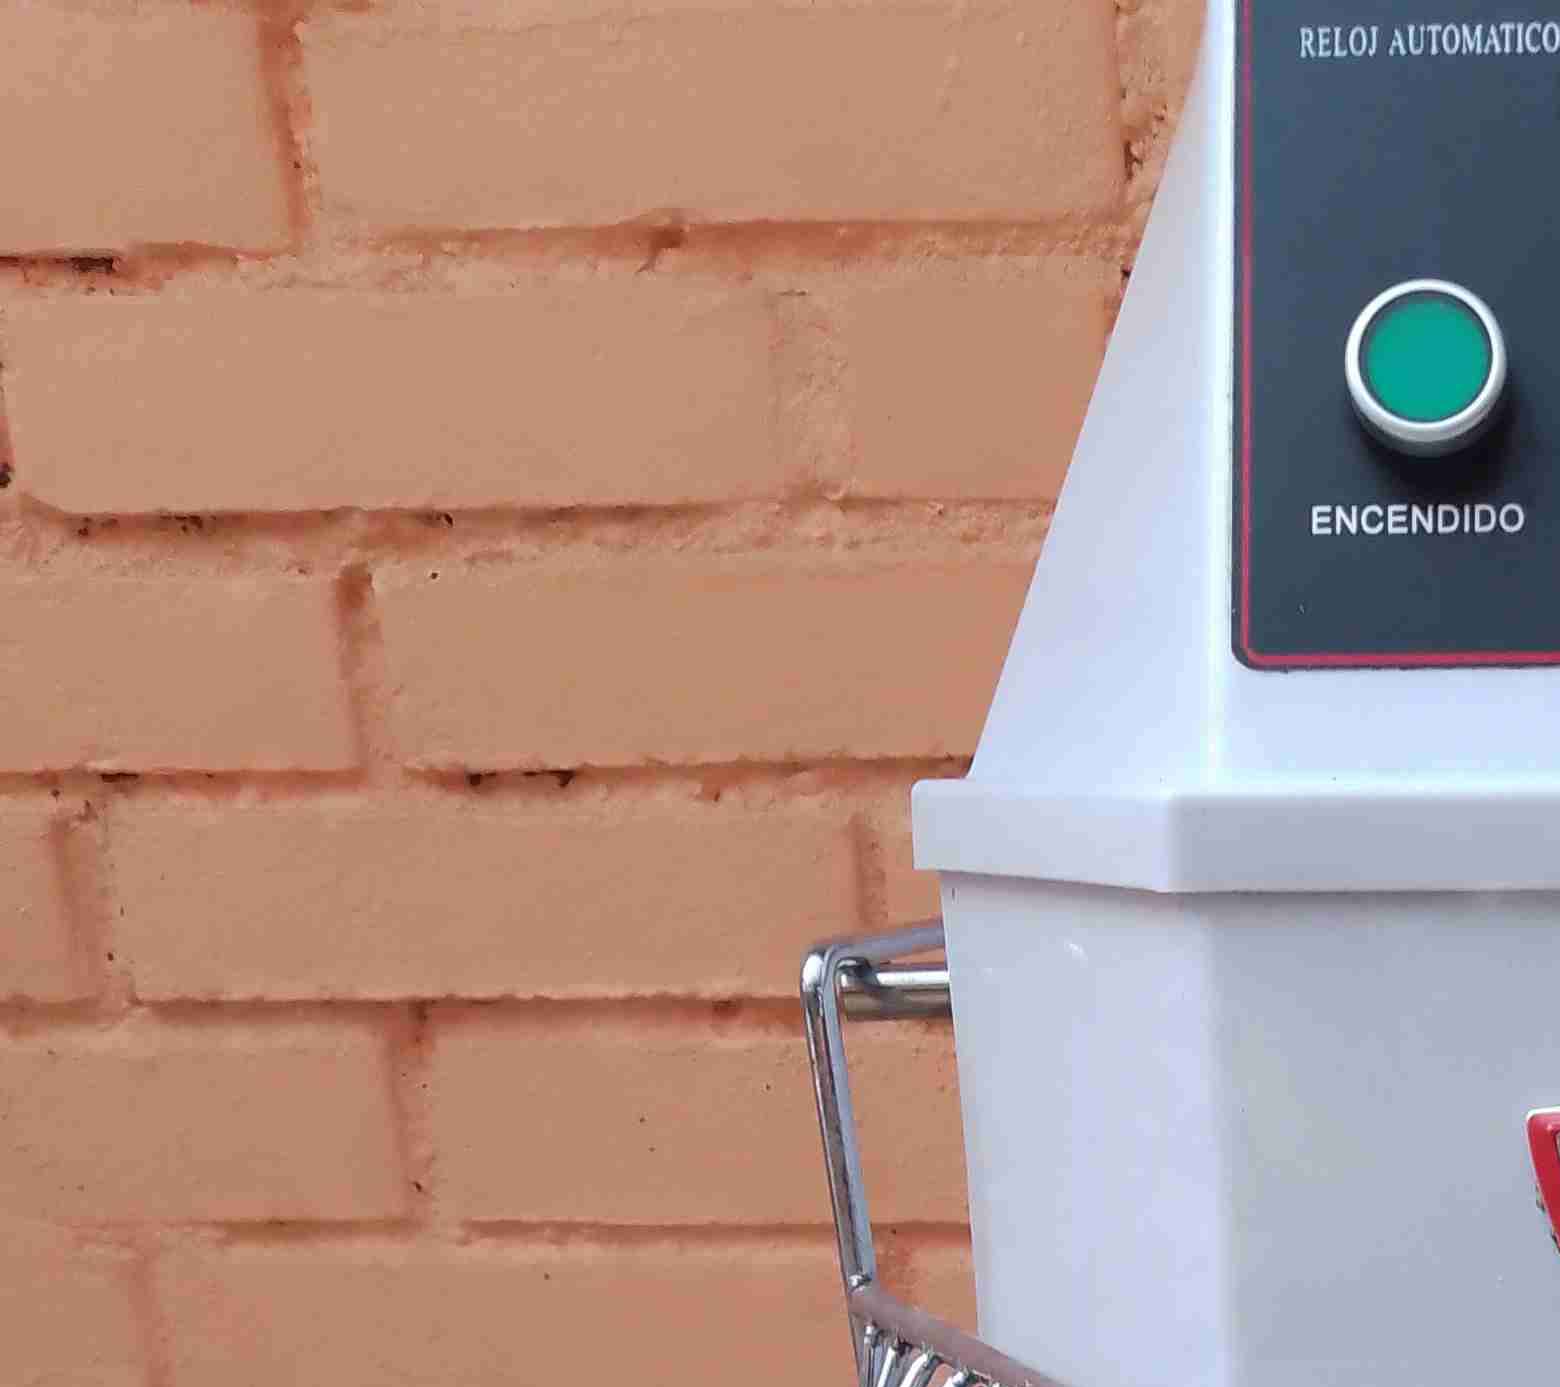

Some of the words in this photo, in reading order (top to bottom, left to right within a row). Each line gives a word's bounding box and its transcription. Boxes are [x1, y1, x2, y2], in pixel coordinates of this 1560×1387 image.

[1300, 26, 1378, 58] RELOJ
[1388, 21, 1560, 56] AUTOMATICO
[1311, 503, 1525, 535] ENCENDIDO
